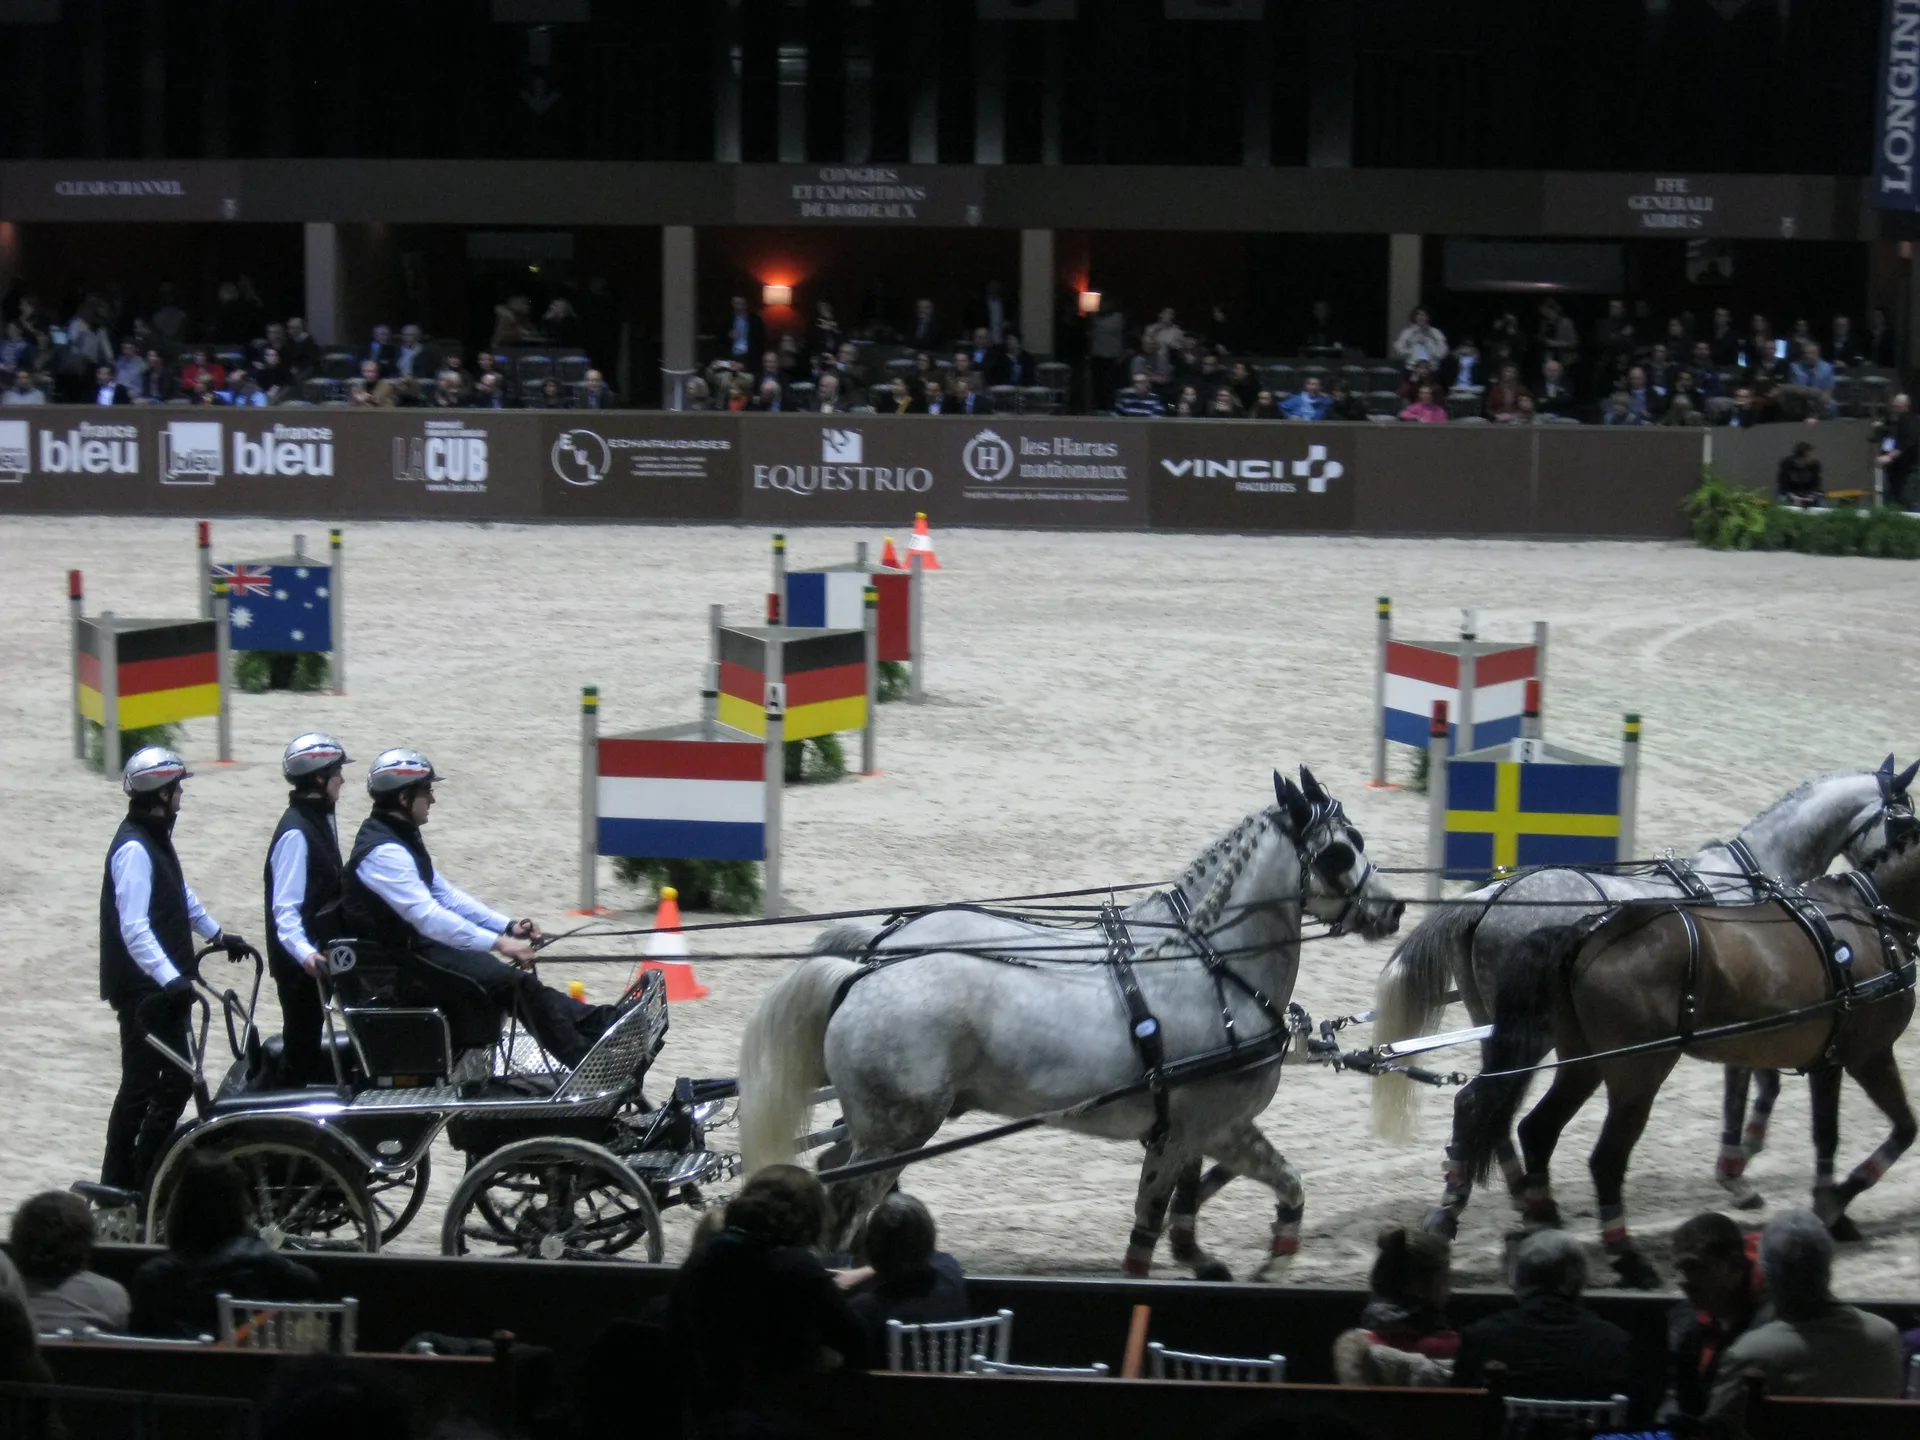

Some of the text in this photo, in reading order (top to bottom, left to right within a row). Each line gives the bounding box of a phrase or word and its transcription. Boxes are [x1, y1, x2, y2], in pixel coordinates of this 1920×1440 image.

[1881, 0, 1920, 194] LONGIN
[79, 420, 139, 439] france
[272, 423, 334, 441] france
[40, 429, 140, 474] bleu
[233, 431, 334, 477] bleu
[976, 446, 1000, 471] H
[1019, 435, 1119, 457] les Haras
[425, 437, 489, 482] CUB
[1019, 461, 1129, 480] nationaux
[1160, 457, 1285, 479] VINCI
[752, 464, 934, 496] EQUESTRIO
